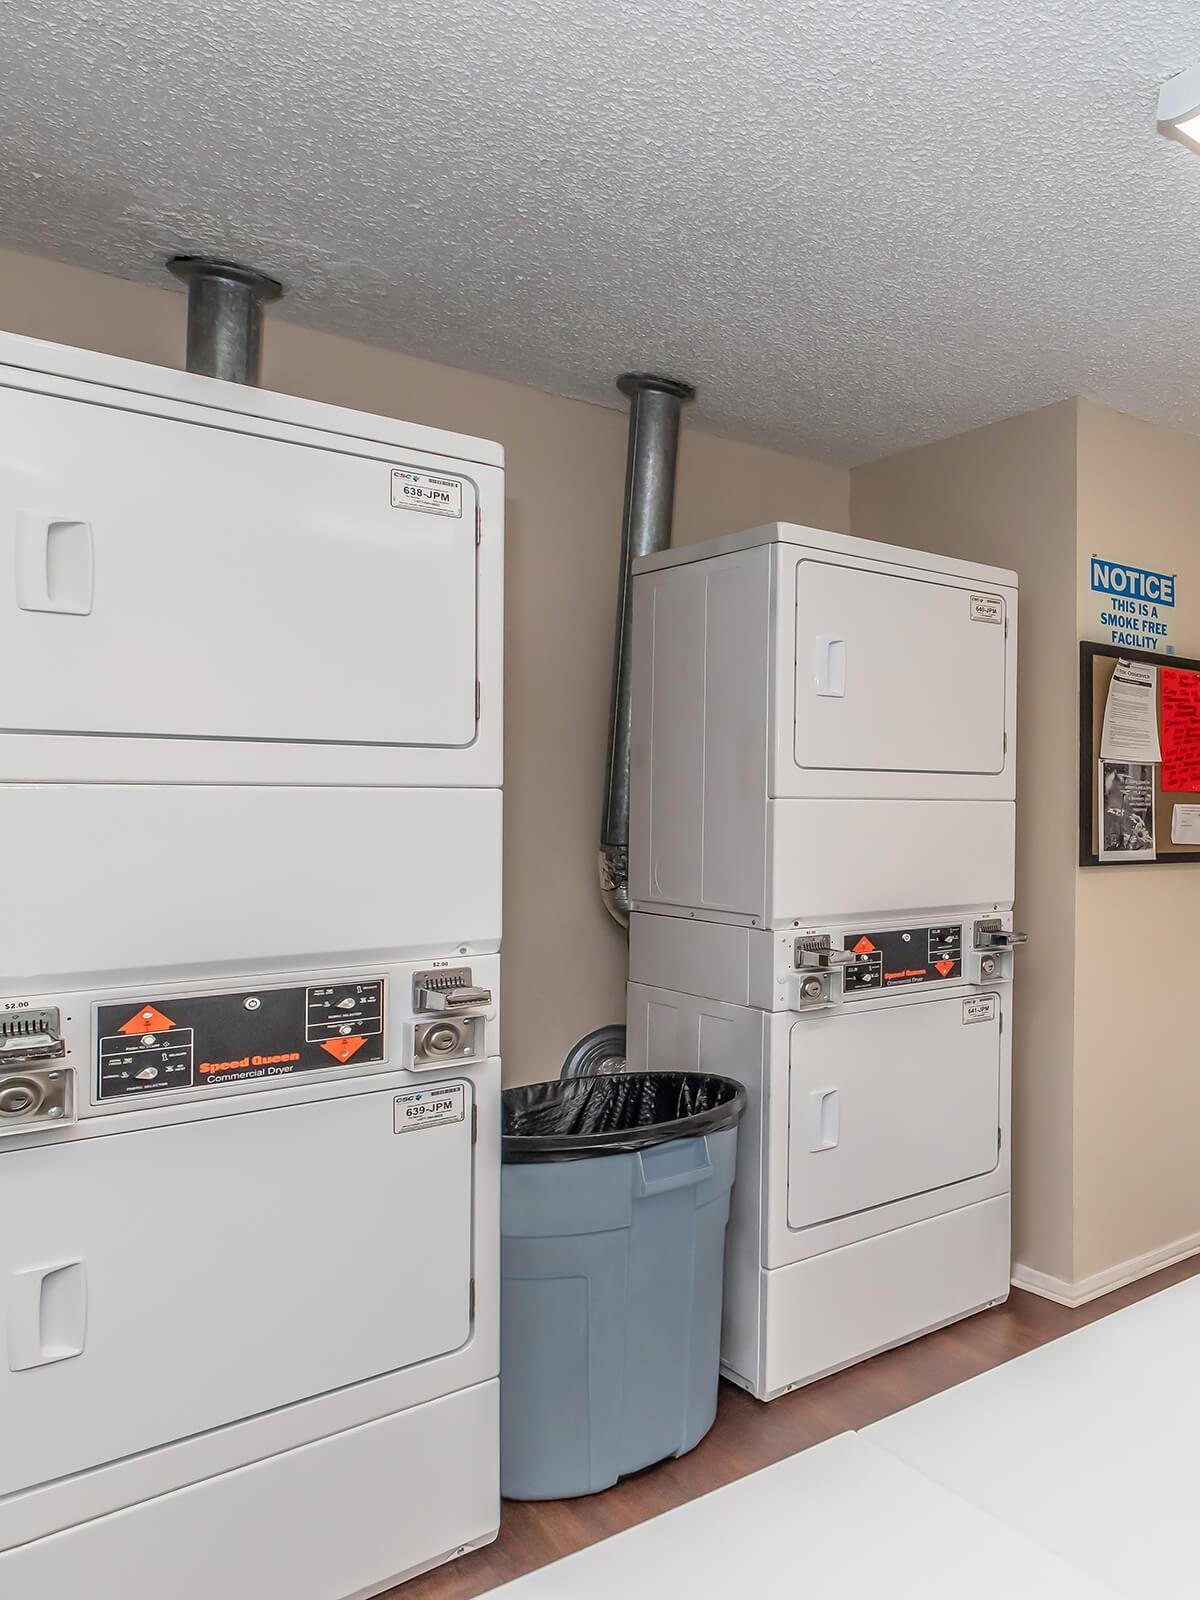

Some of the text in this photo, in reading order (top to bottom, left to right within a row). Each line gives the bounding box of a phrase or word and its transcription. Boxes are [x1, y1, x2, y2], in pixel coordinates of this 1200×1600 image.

[403, 486, 450, 502] 638-JPM
[1093, 563, 1173, 602] NOTICE
[1111, 597, 1158, 619] THIS IS A
[1100, 612, 1168, 636] SMOKE FREE
[1111, 630, 1158, 650] FACILITY
[4, 1001, 29, 1010] $2.00
[199, 1056, 250, 1074] Speed
[251, 1052, 300, 1066] Queen
[207, 1065, 294, 1084] Commercial Dryer
[406, 1100, 453, 1117] 639-JPM
